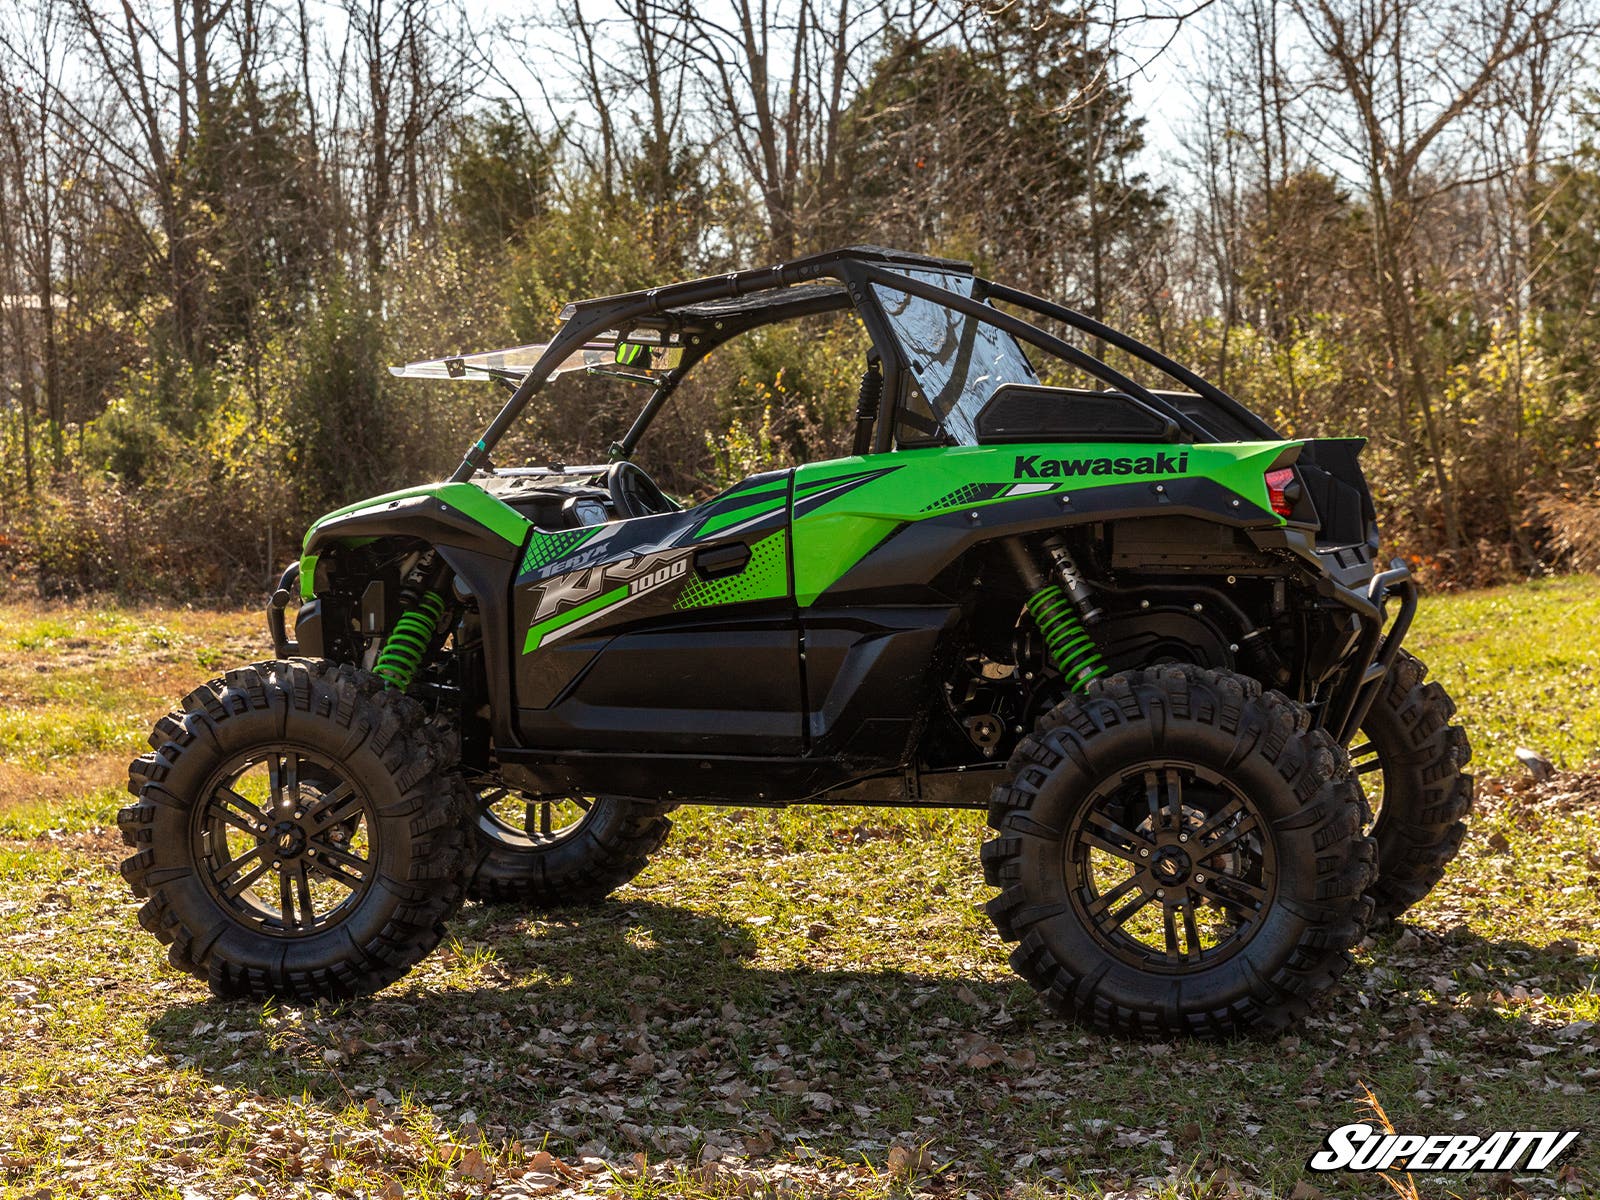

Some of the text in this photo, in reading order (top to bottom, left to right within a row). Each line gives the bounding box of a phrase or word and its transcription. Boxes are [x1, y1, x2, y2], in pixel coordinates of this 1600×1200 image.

[1014, 452, 1188, 479] Kawasaki
[528, 523, 698, 625] KRX
[538, 542, 610, 578] TERYX
[630, 558, 687, 595] 1000
